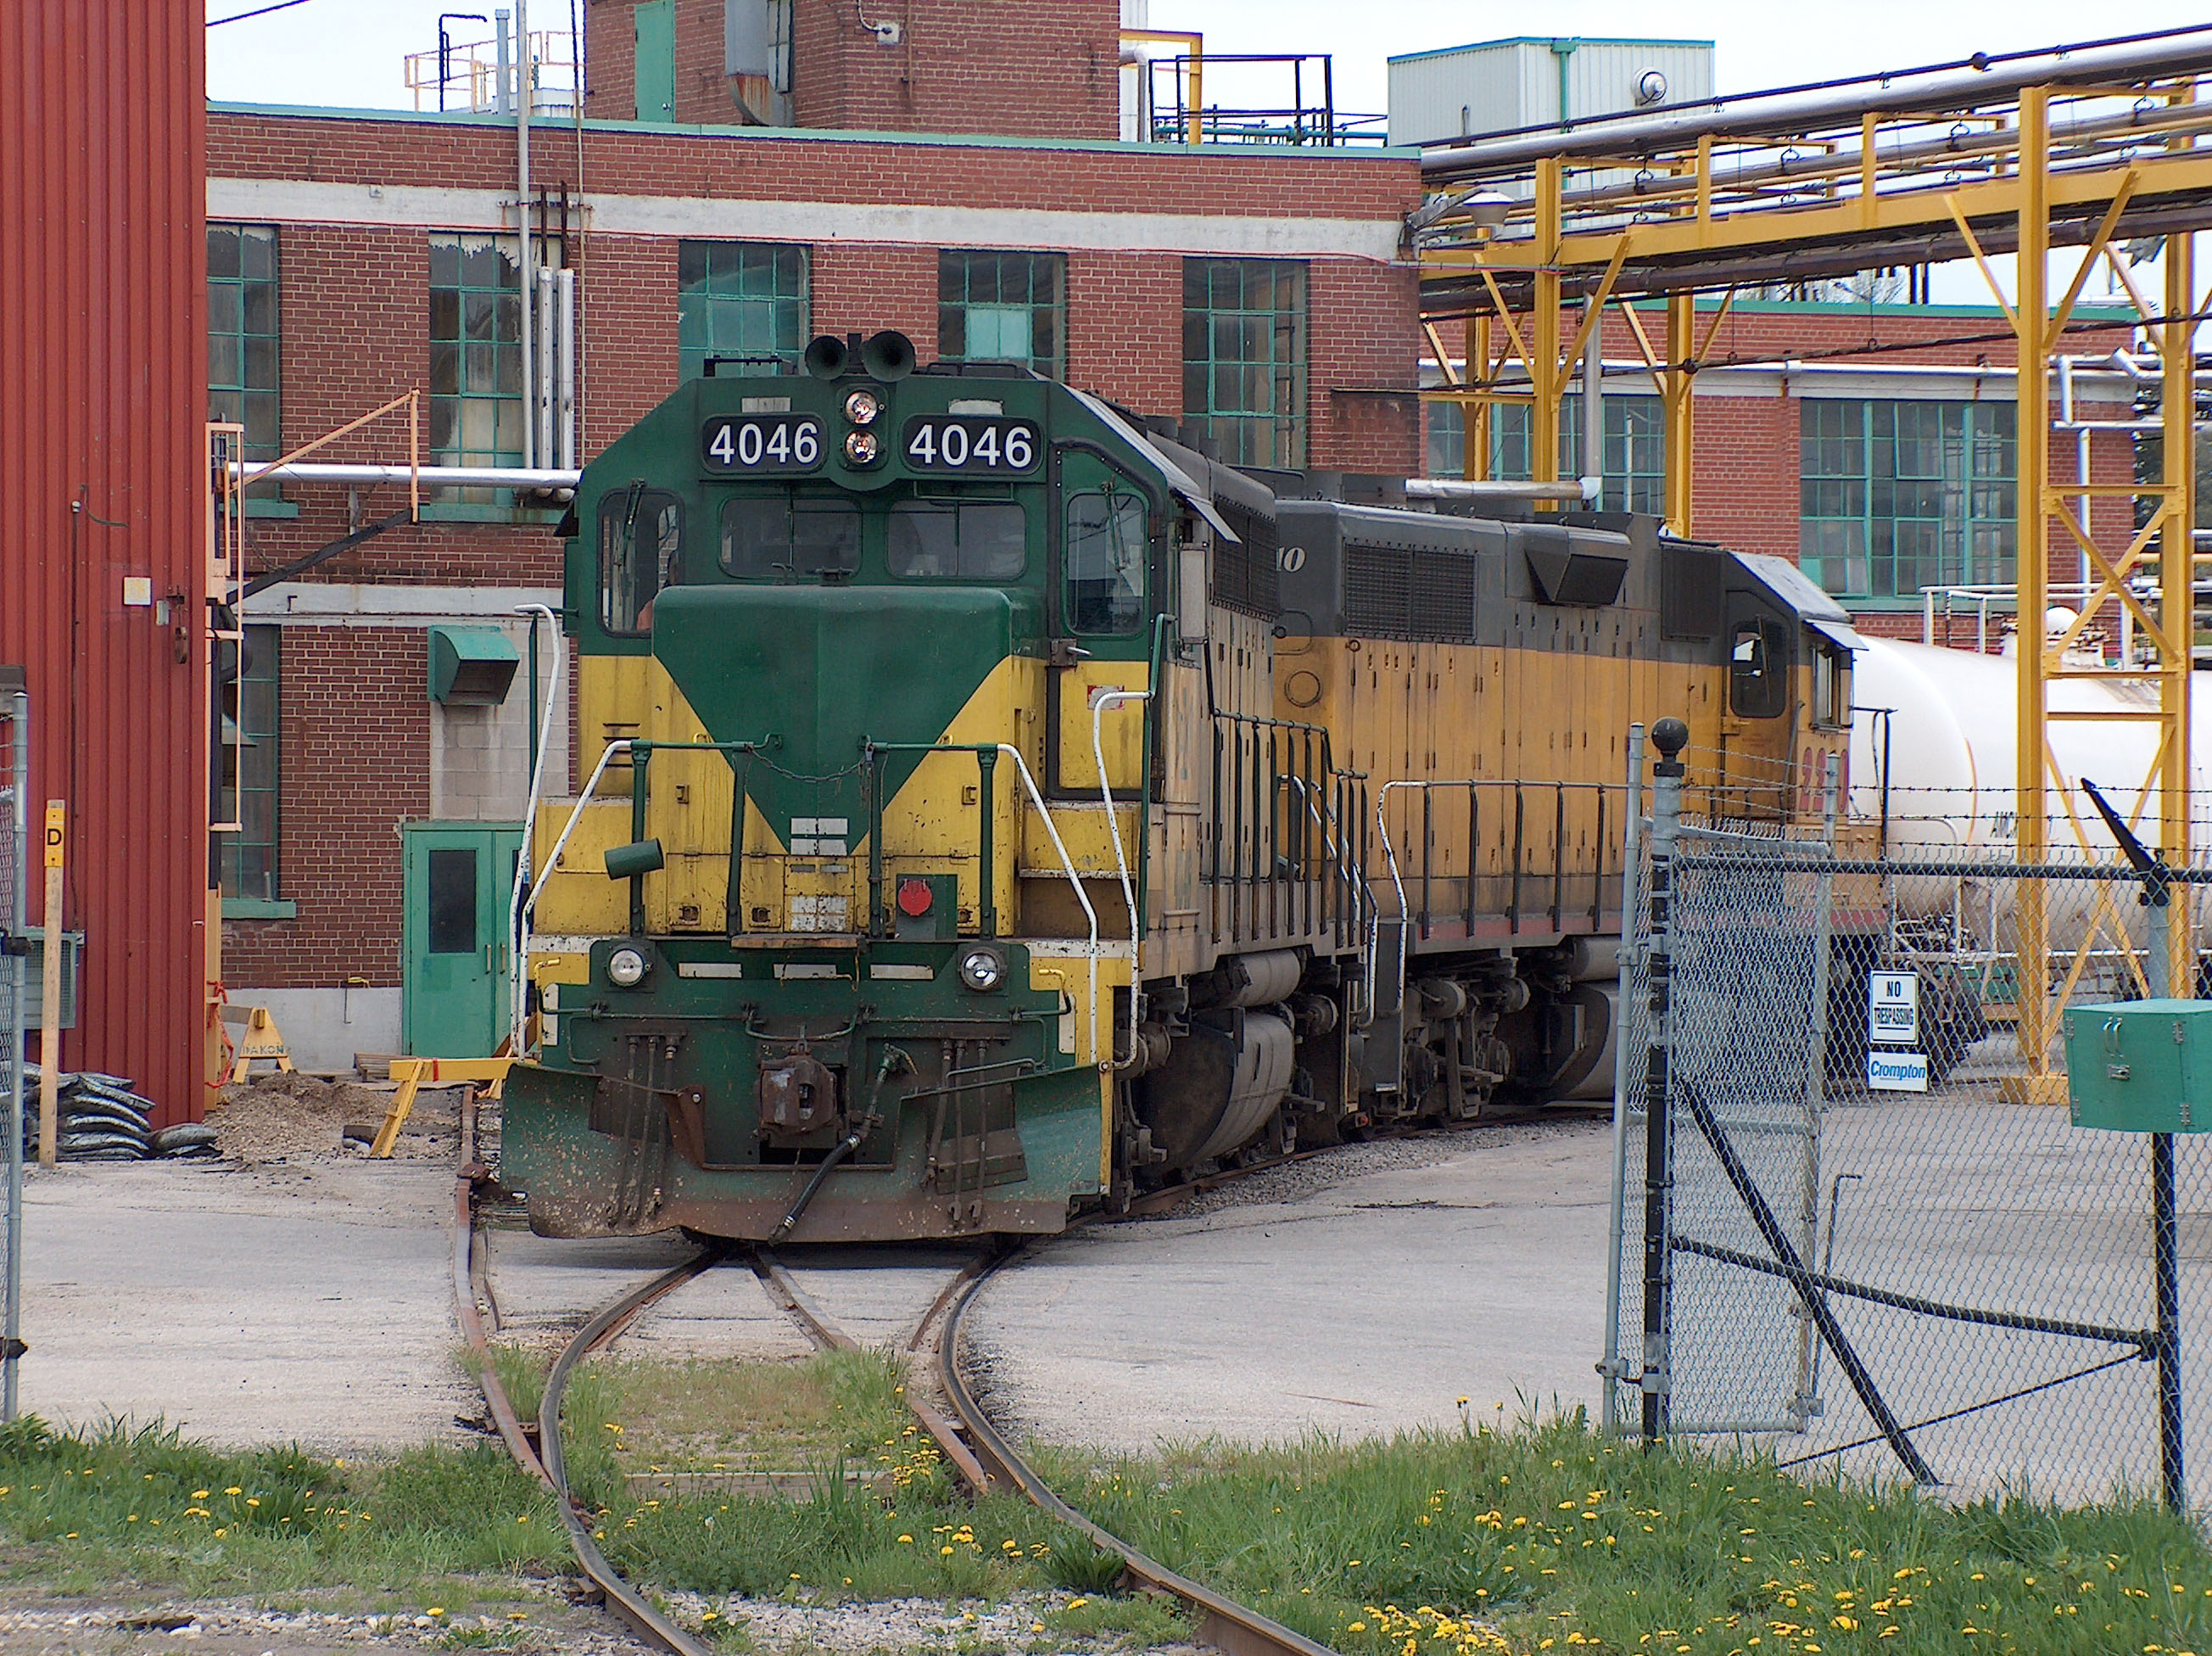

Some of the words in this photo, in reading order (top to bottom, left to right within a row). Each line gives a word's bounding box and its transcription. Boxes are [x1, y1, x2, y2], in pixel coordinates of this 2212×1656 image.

[709, 422, 819, 464] 4046
[908, 424, 1033, 468] 4046
[47, 828, 62, 846] D
[1886, 981, 1902, 998] NO
[1874, 1007, 1914, 1026] TRESPASSING
[1871, 1060, 1926, 1081] Crompton
